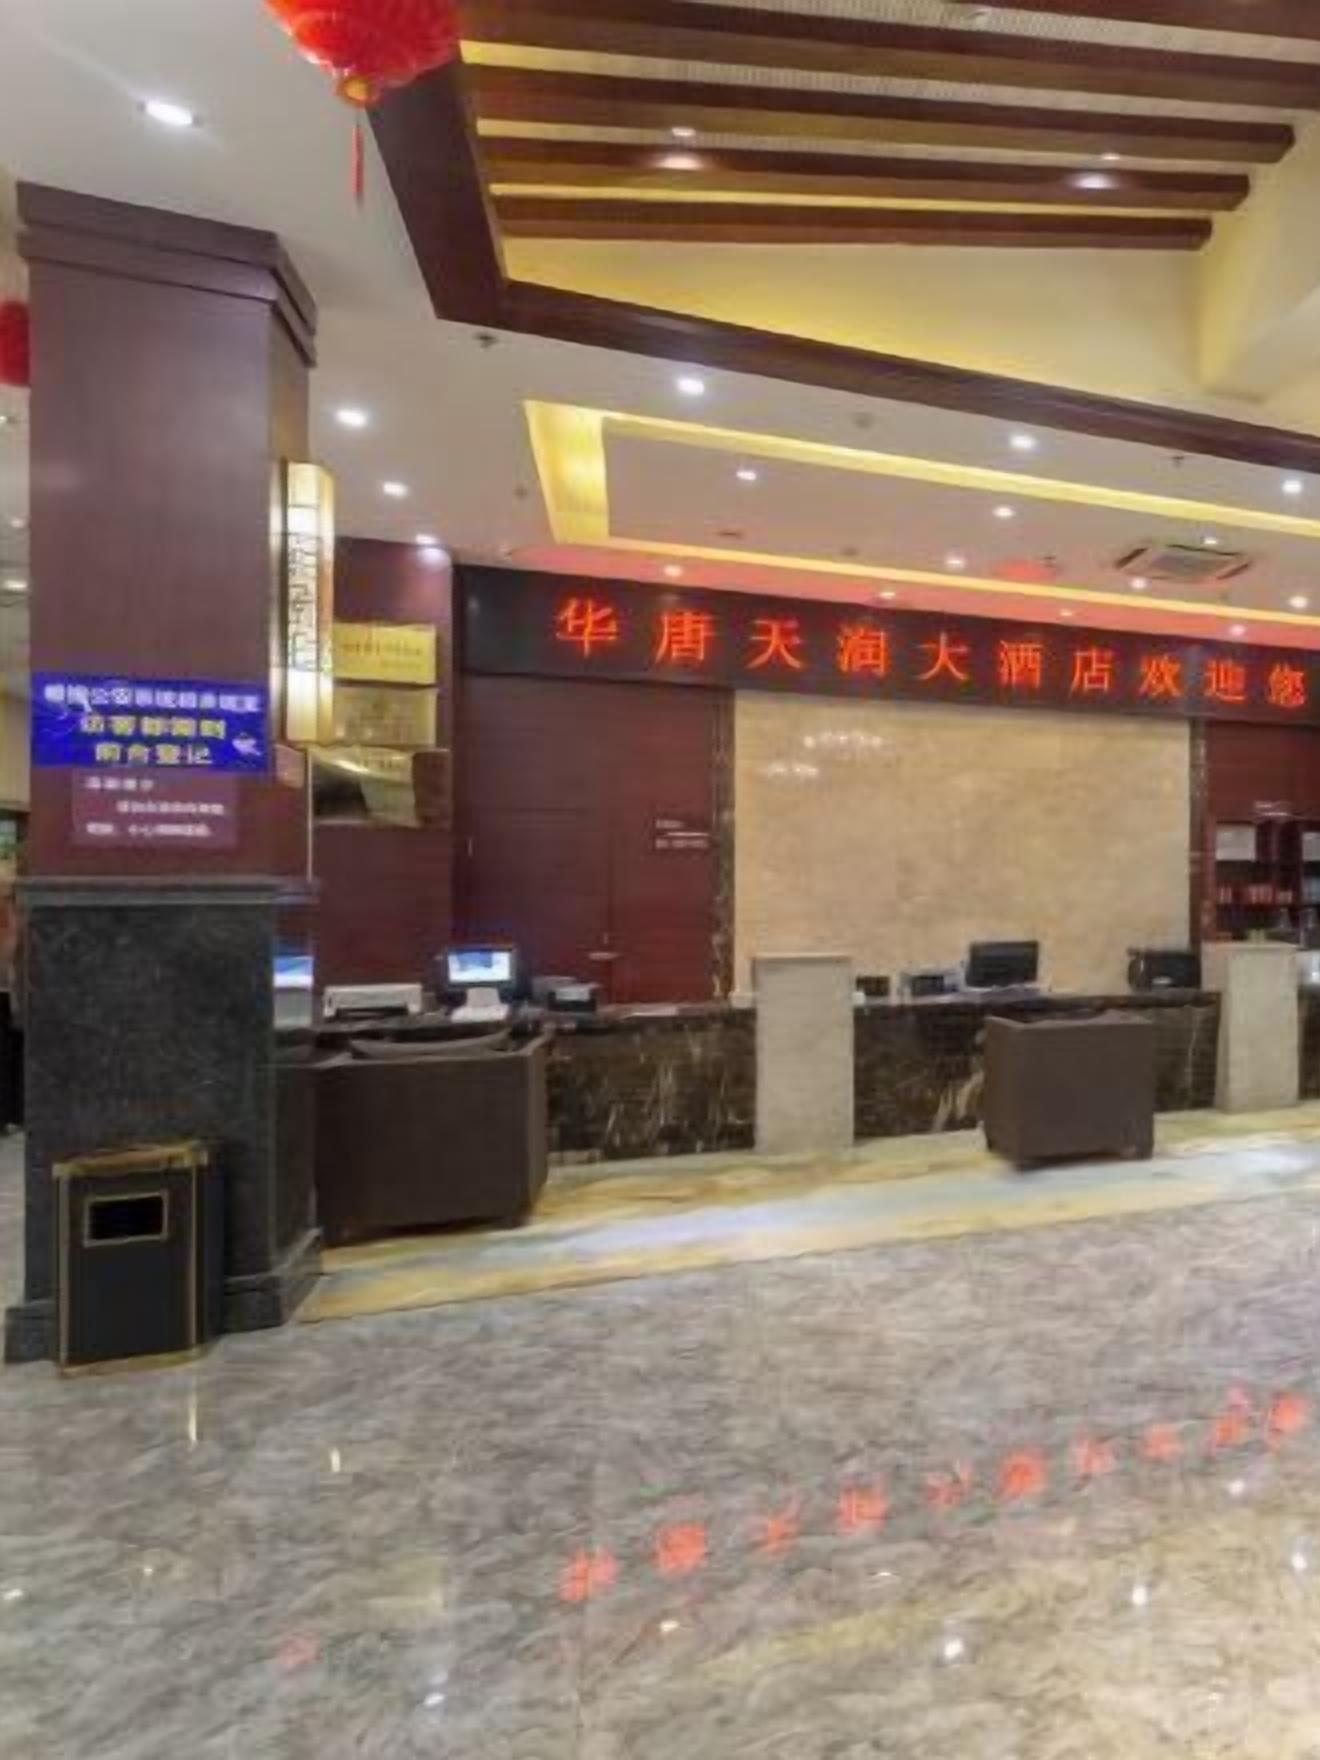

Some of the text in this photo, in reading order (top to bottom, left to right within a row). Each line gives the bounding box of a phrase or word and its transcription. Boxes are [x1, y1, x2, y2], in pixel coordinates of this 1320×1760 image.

[555, 598, 1306, 708] 华唐天润大酒店欢迎您
